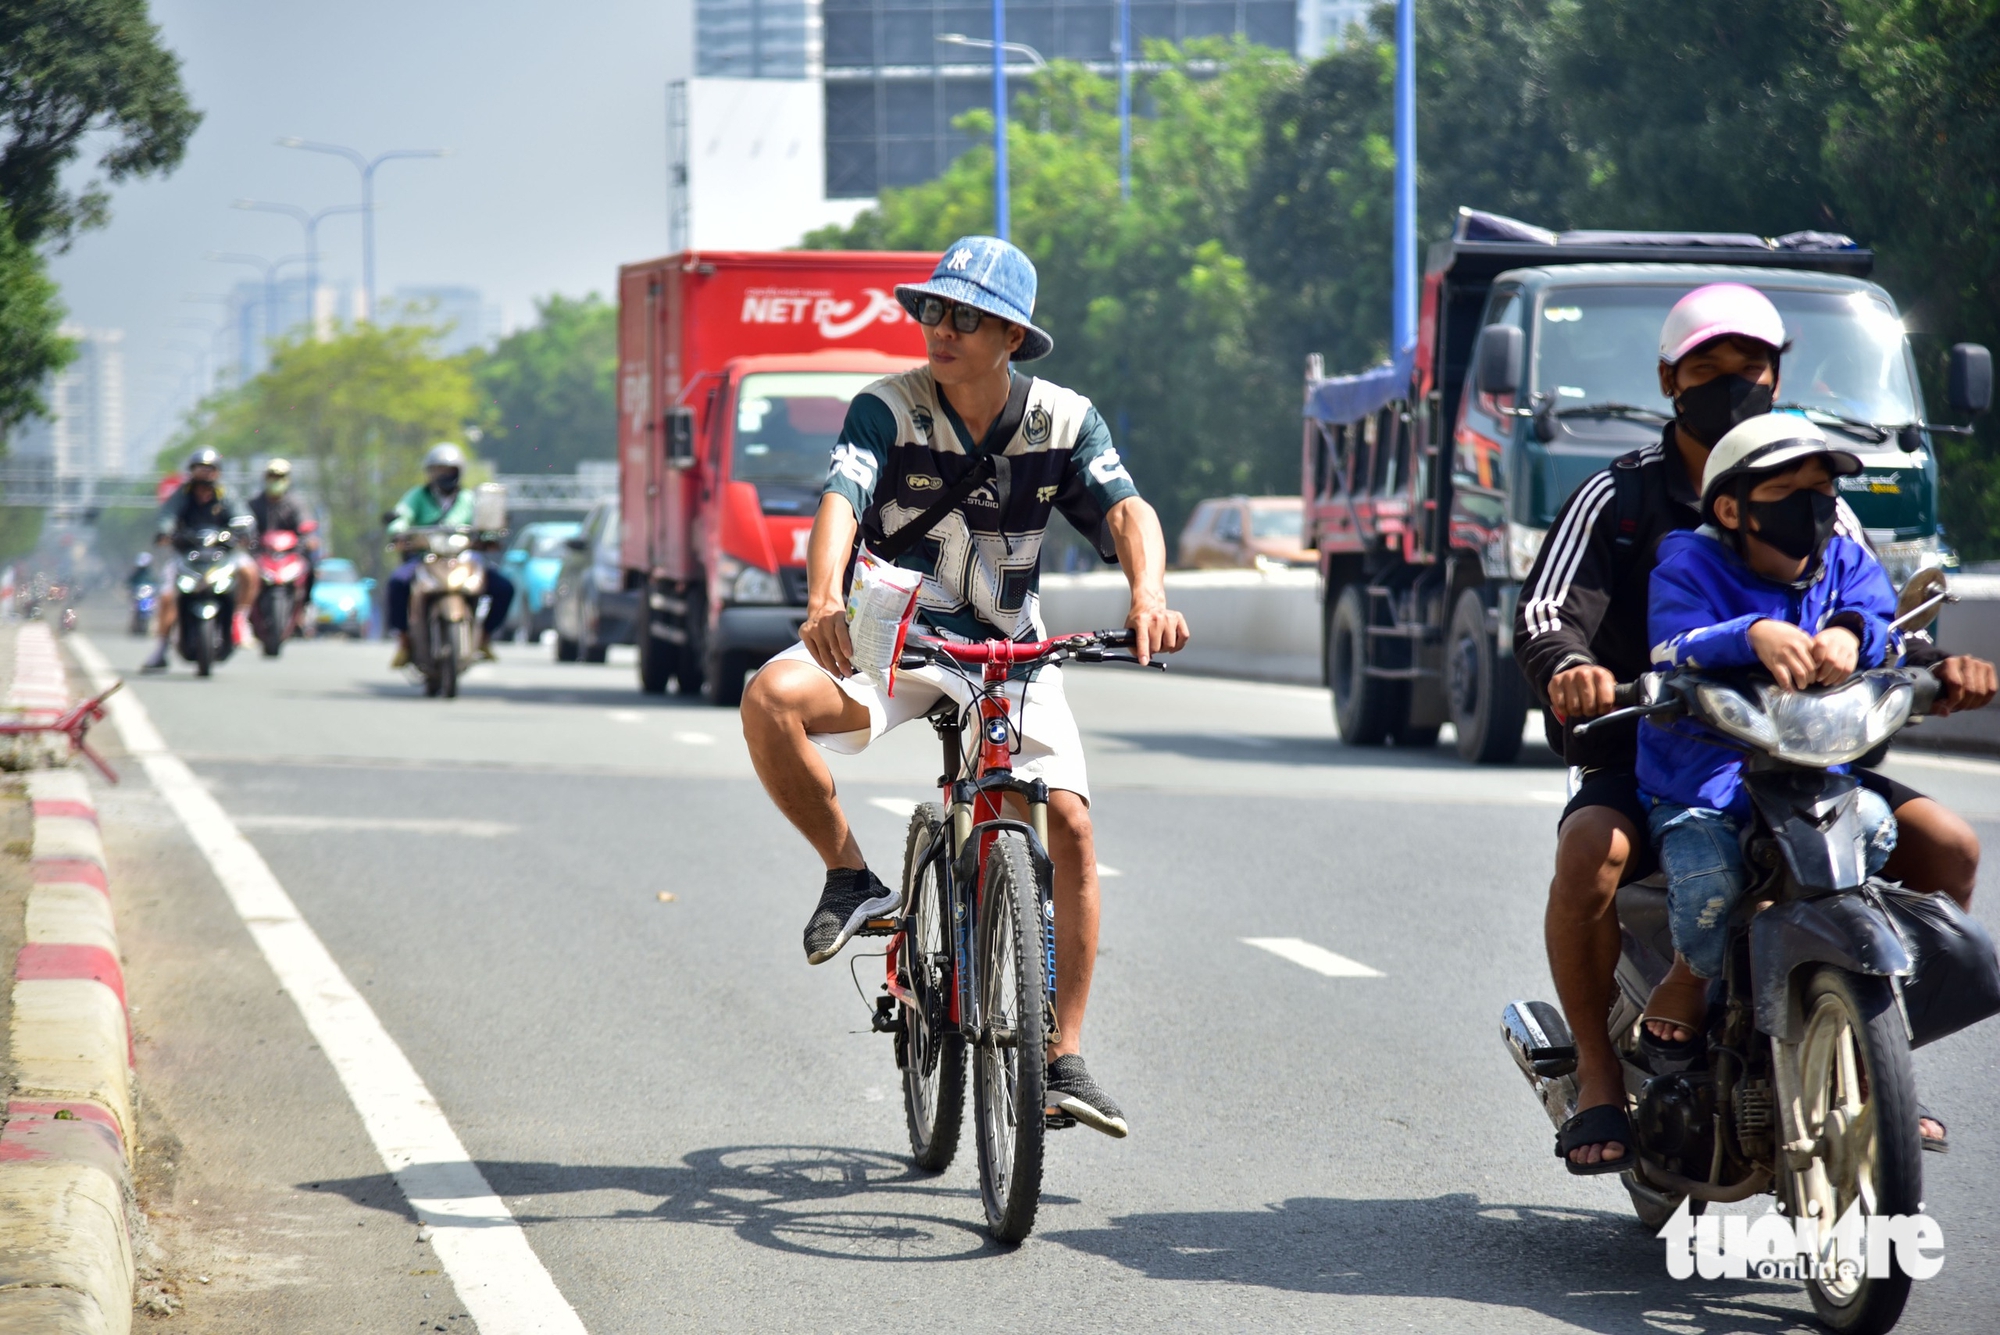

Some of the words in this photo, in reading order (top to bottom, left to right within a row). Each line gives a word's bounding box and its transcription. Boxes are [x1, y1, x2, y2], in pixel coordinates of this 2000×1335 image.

[947, 247, 973, 270] NY
[739, 297, 811, 324] NET
[967, 497, 999, 509] STUDIO
